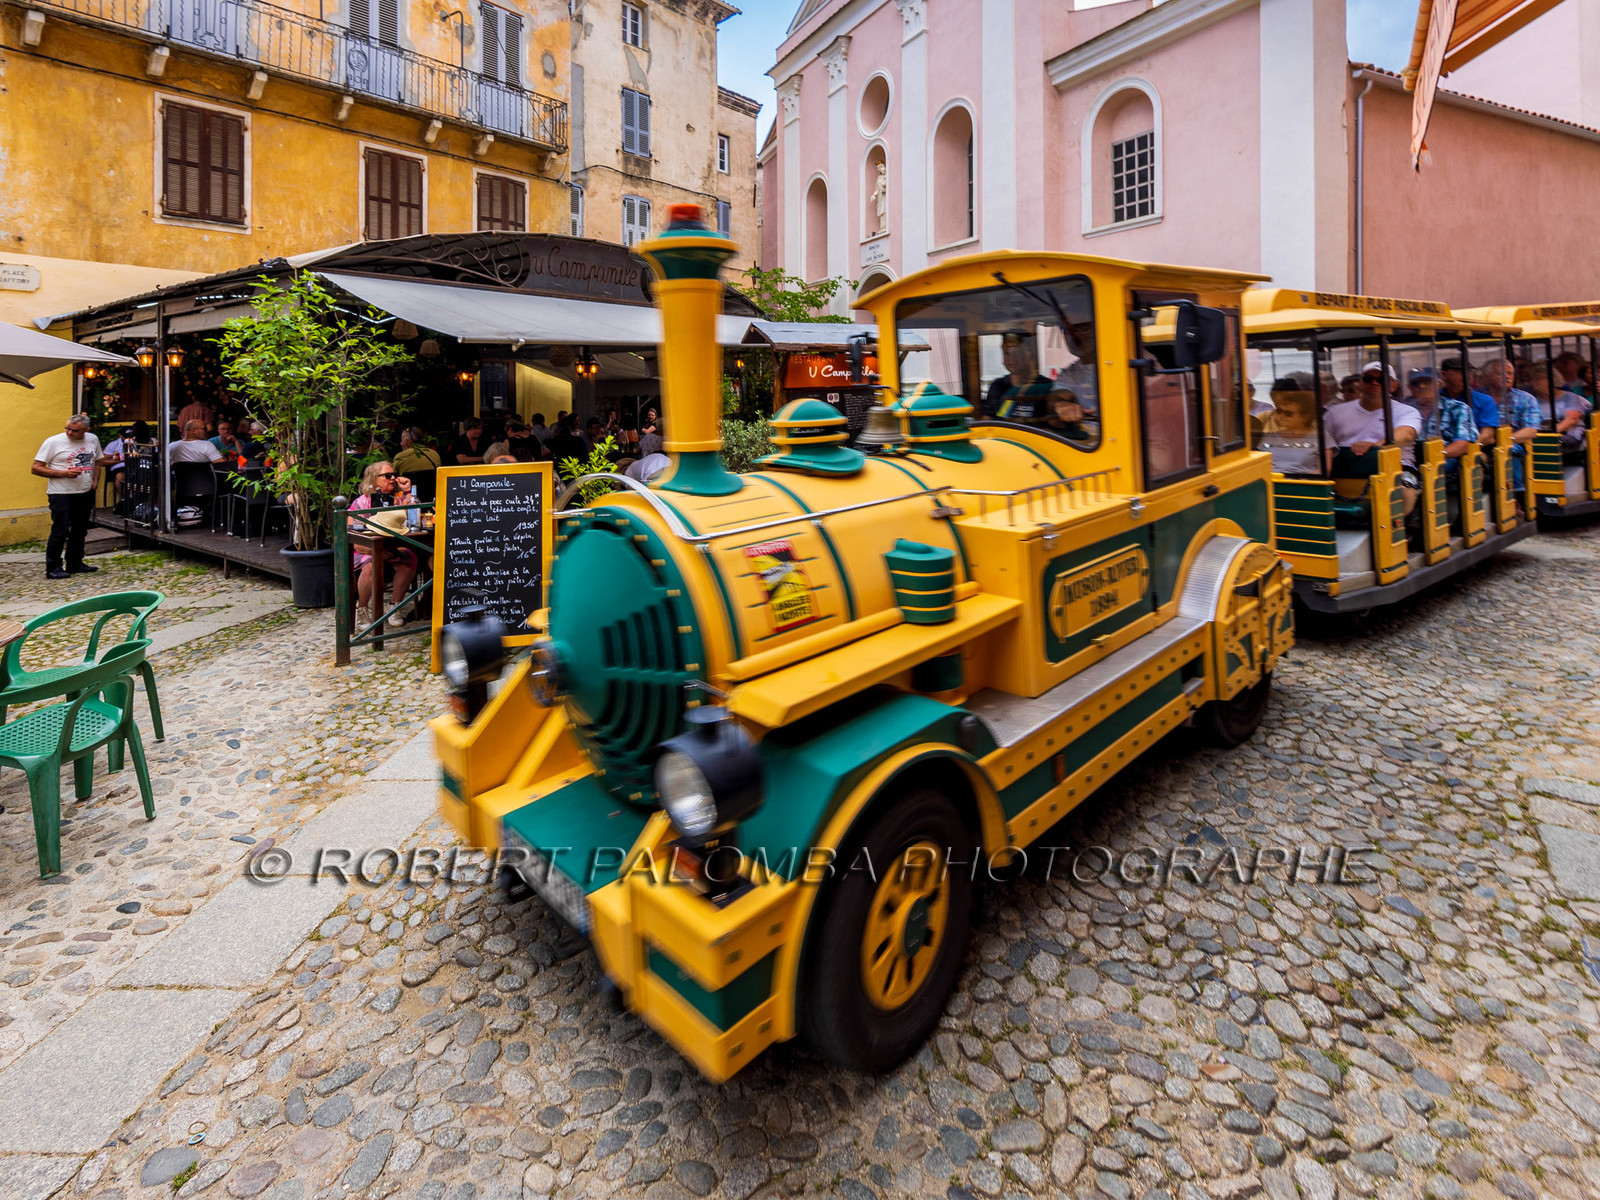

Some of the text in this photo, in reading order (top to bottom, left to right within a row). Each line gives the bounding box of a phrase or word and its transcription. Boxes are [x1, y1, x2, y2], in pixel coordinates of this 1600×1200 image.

[547, 245, 638, 292] Campanile
[1315, 292, 1350, 307] DEPART
[1366, 297, 1393, 311] PLACE
[1394, 299, 1421, 313] PASCAL
[808, 365, 875, 380] U Campile
[480, 497, 488, 506] de
[489, 499, 502, 511] porc
